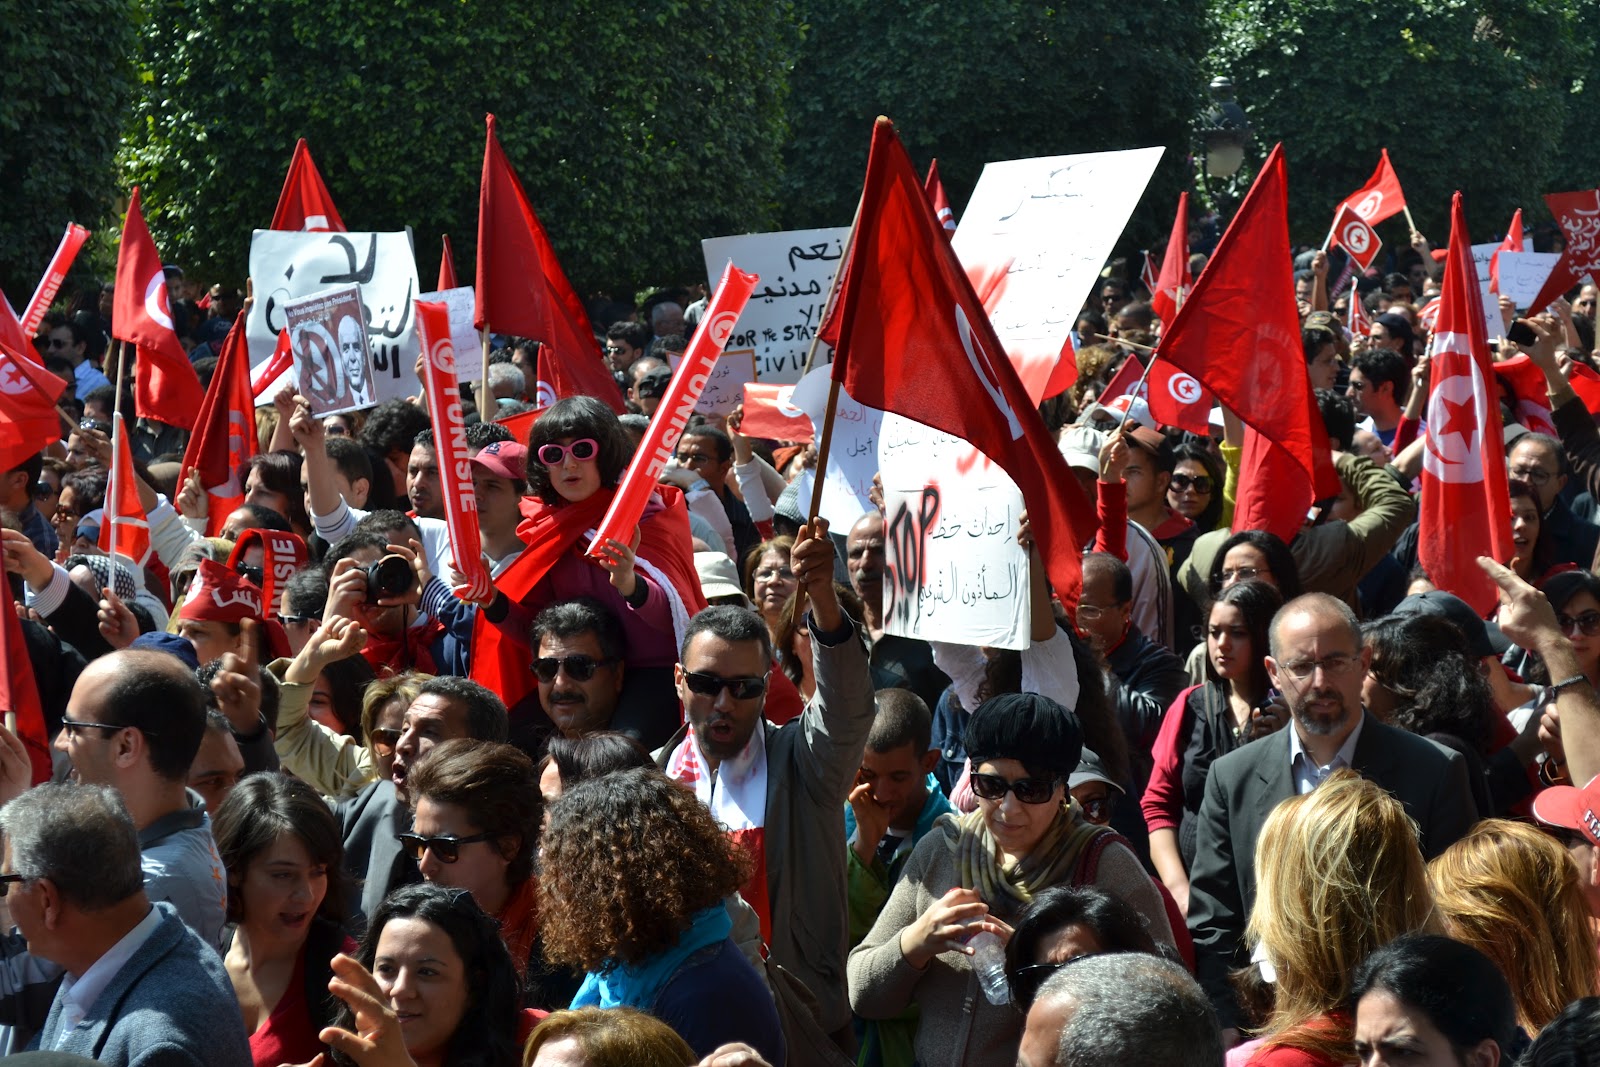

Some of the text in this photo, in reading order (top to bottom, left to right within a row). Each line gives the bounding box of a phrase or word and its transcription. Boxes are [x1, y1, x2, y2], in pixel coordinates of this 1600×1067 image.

[788, 239, 843, 272] نعم
[24, 271, 66, 338] TUNISIE
[444, 387, 478, 513] TUNISIE
[645, 354, 719, 479] TUNISIE
[846, 437, 873, 457] أجل
